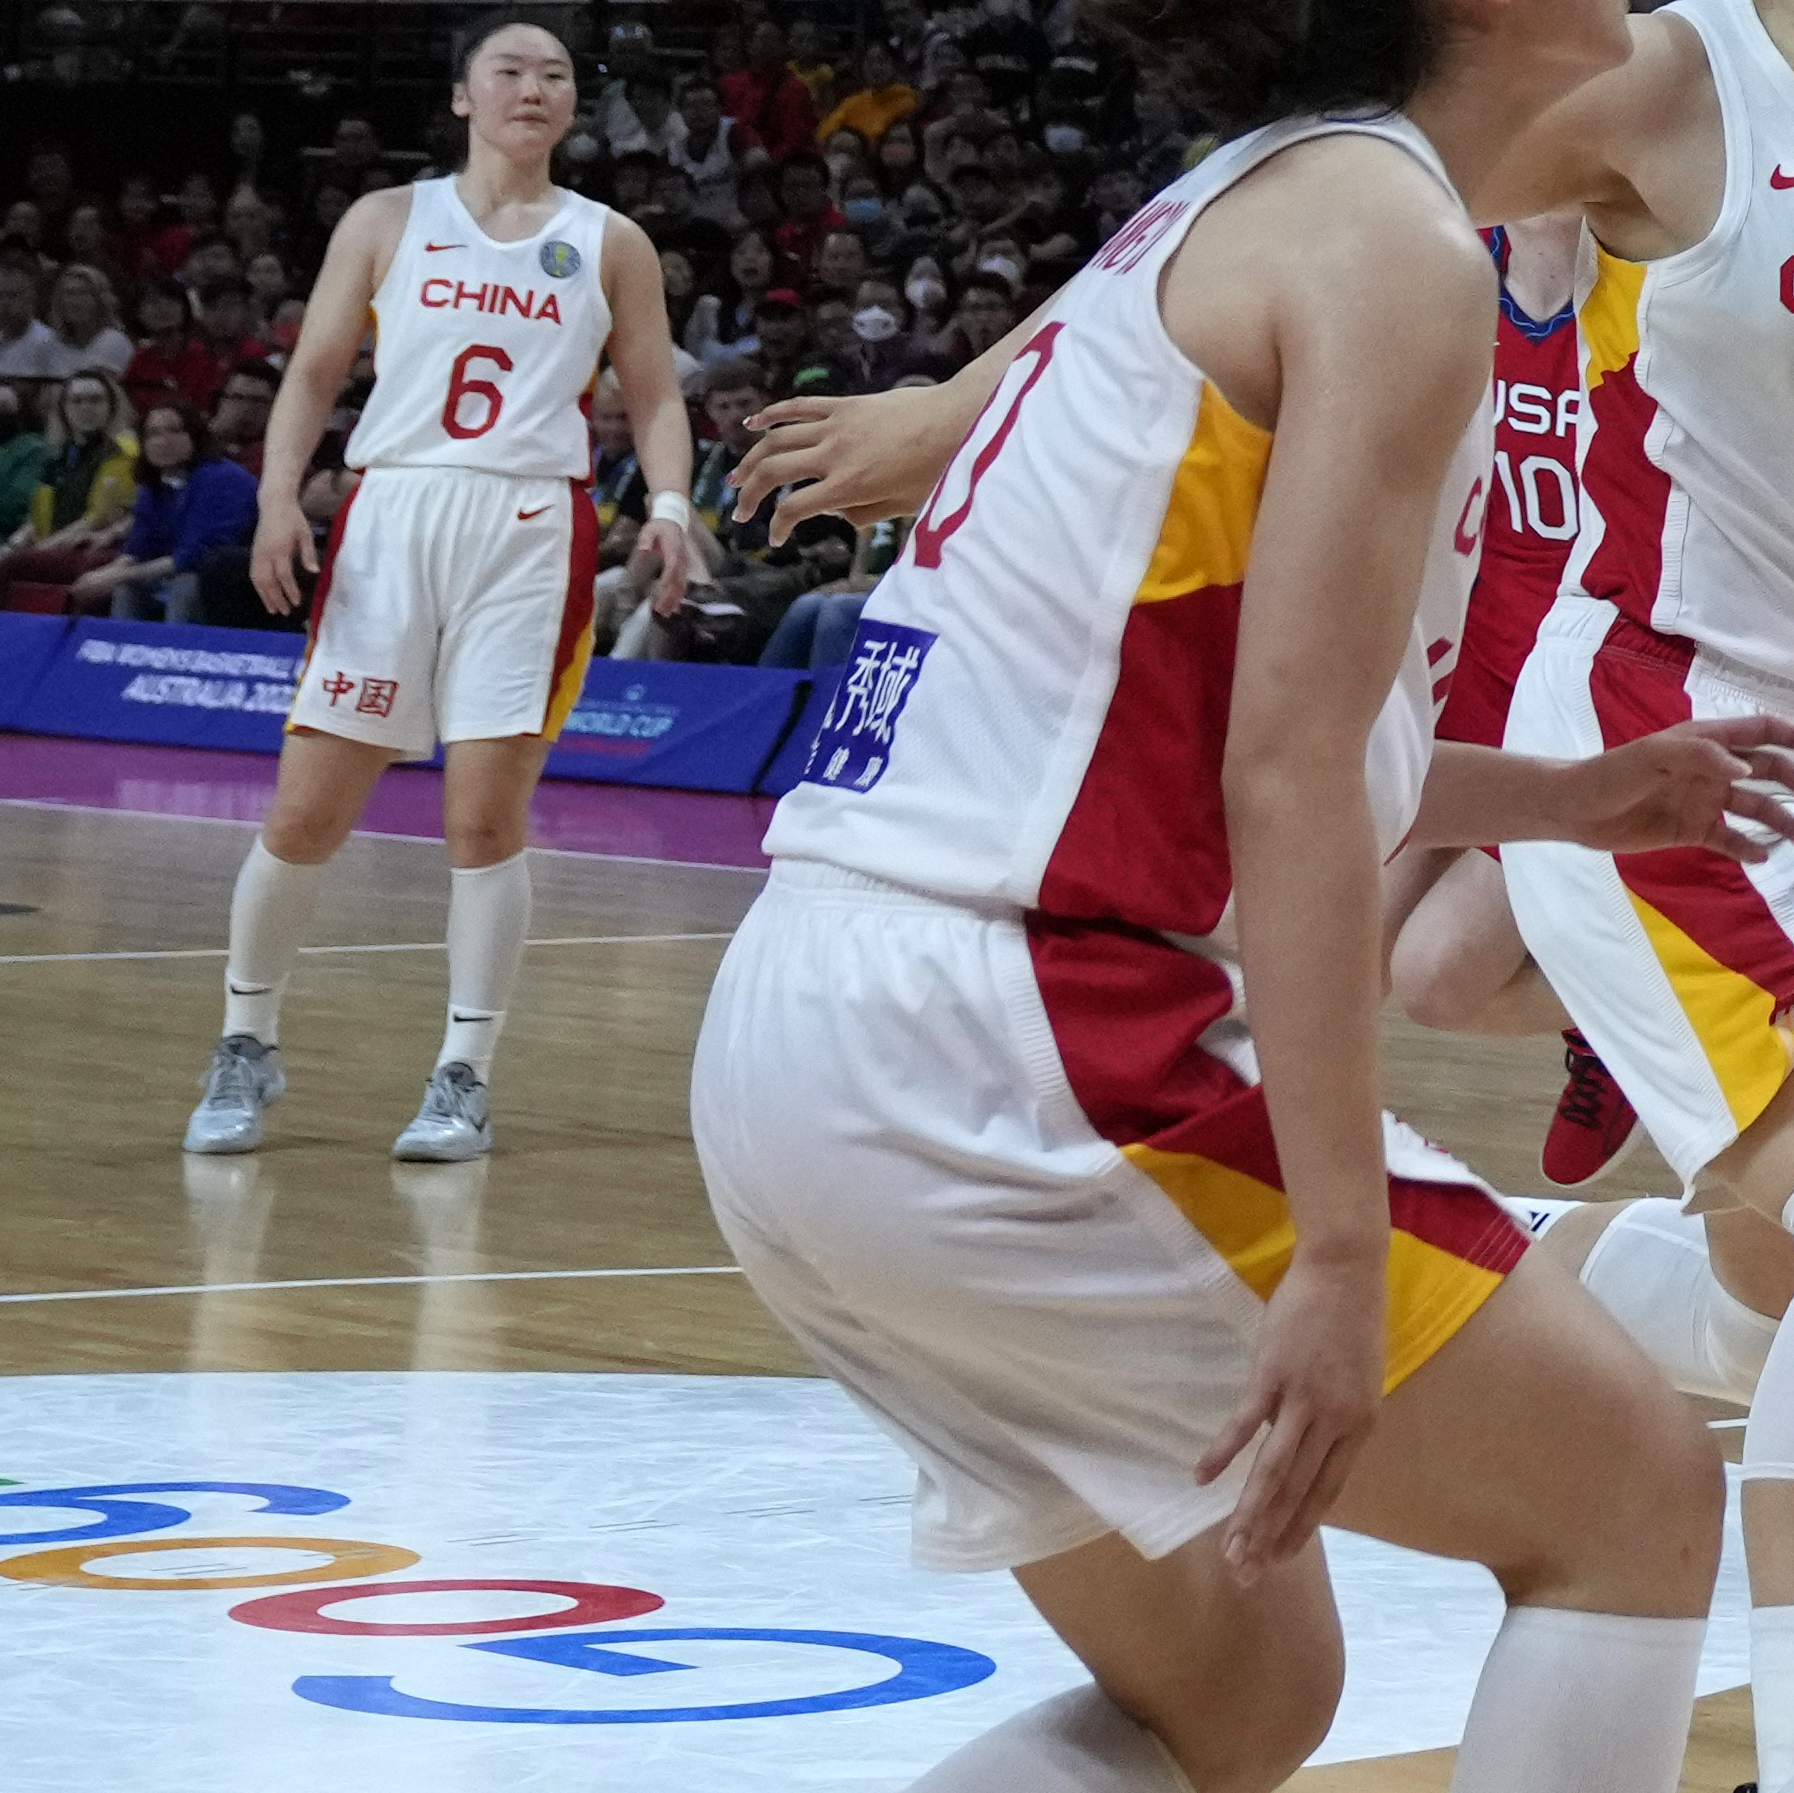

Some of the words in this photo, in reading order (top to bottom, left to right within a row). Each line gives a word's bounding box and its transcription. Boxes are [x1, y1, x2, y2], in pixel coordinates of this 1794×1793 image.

[420, 278, 563, 327] CHINA
[440, 343, 515, 440] 6
[1494, 450, 1580, 542] 10
[322, 670, 399, 718] 中国
